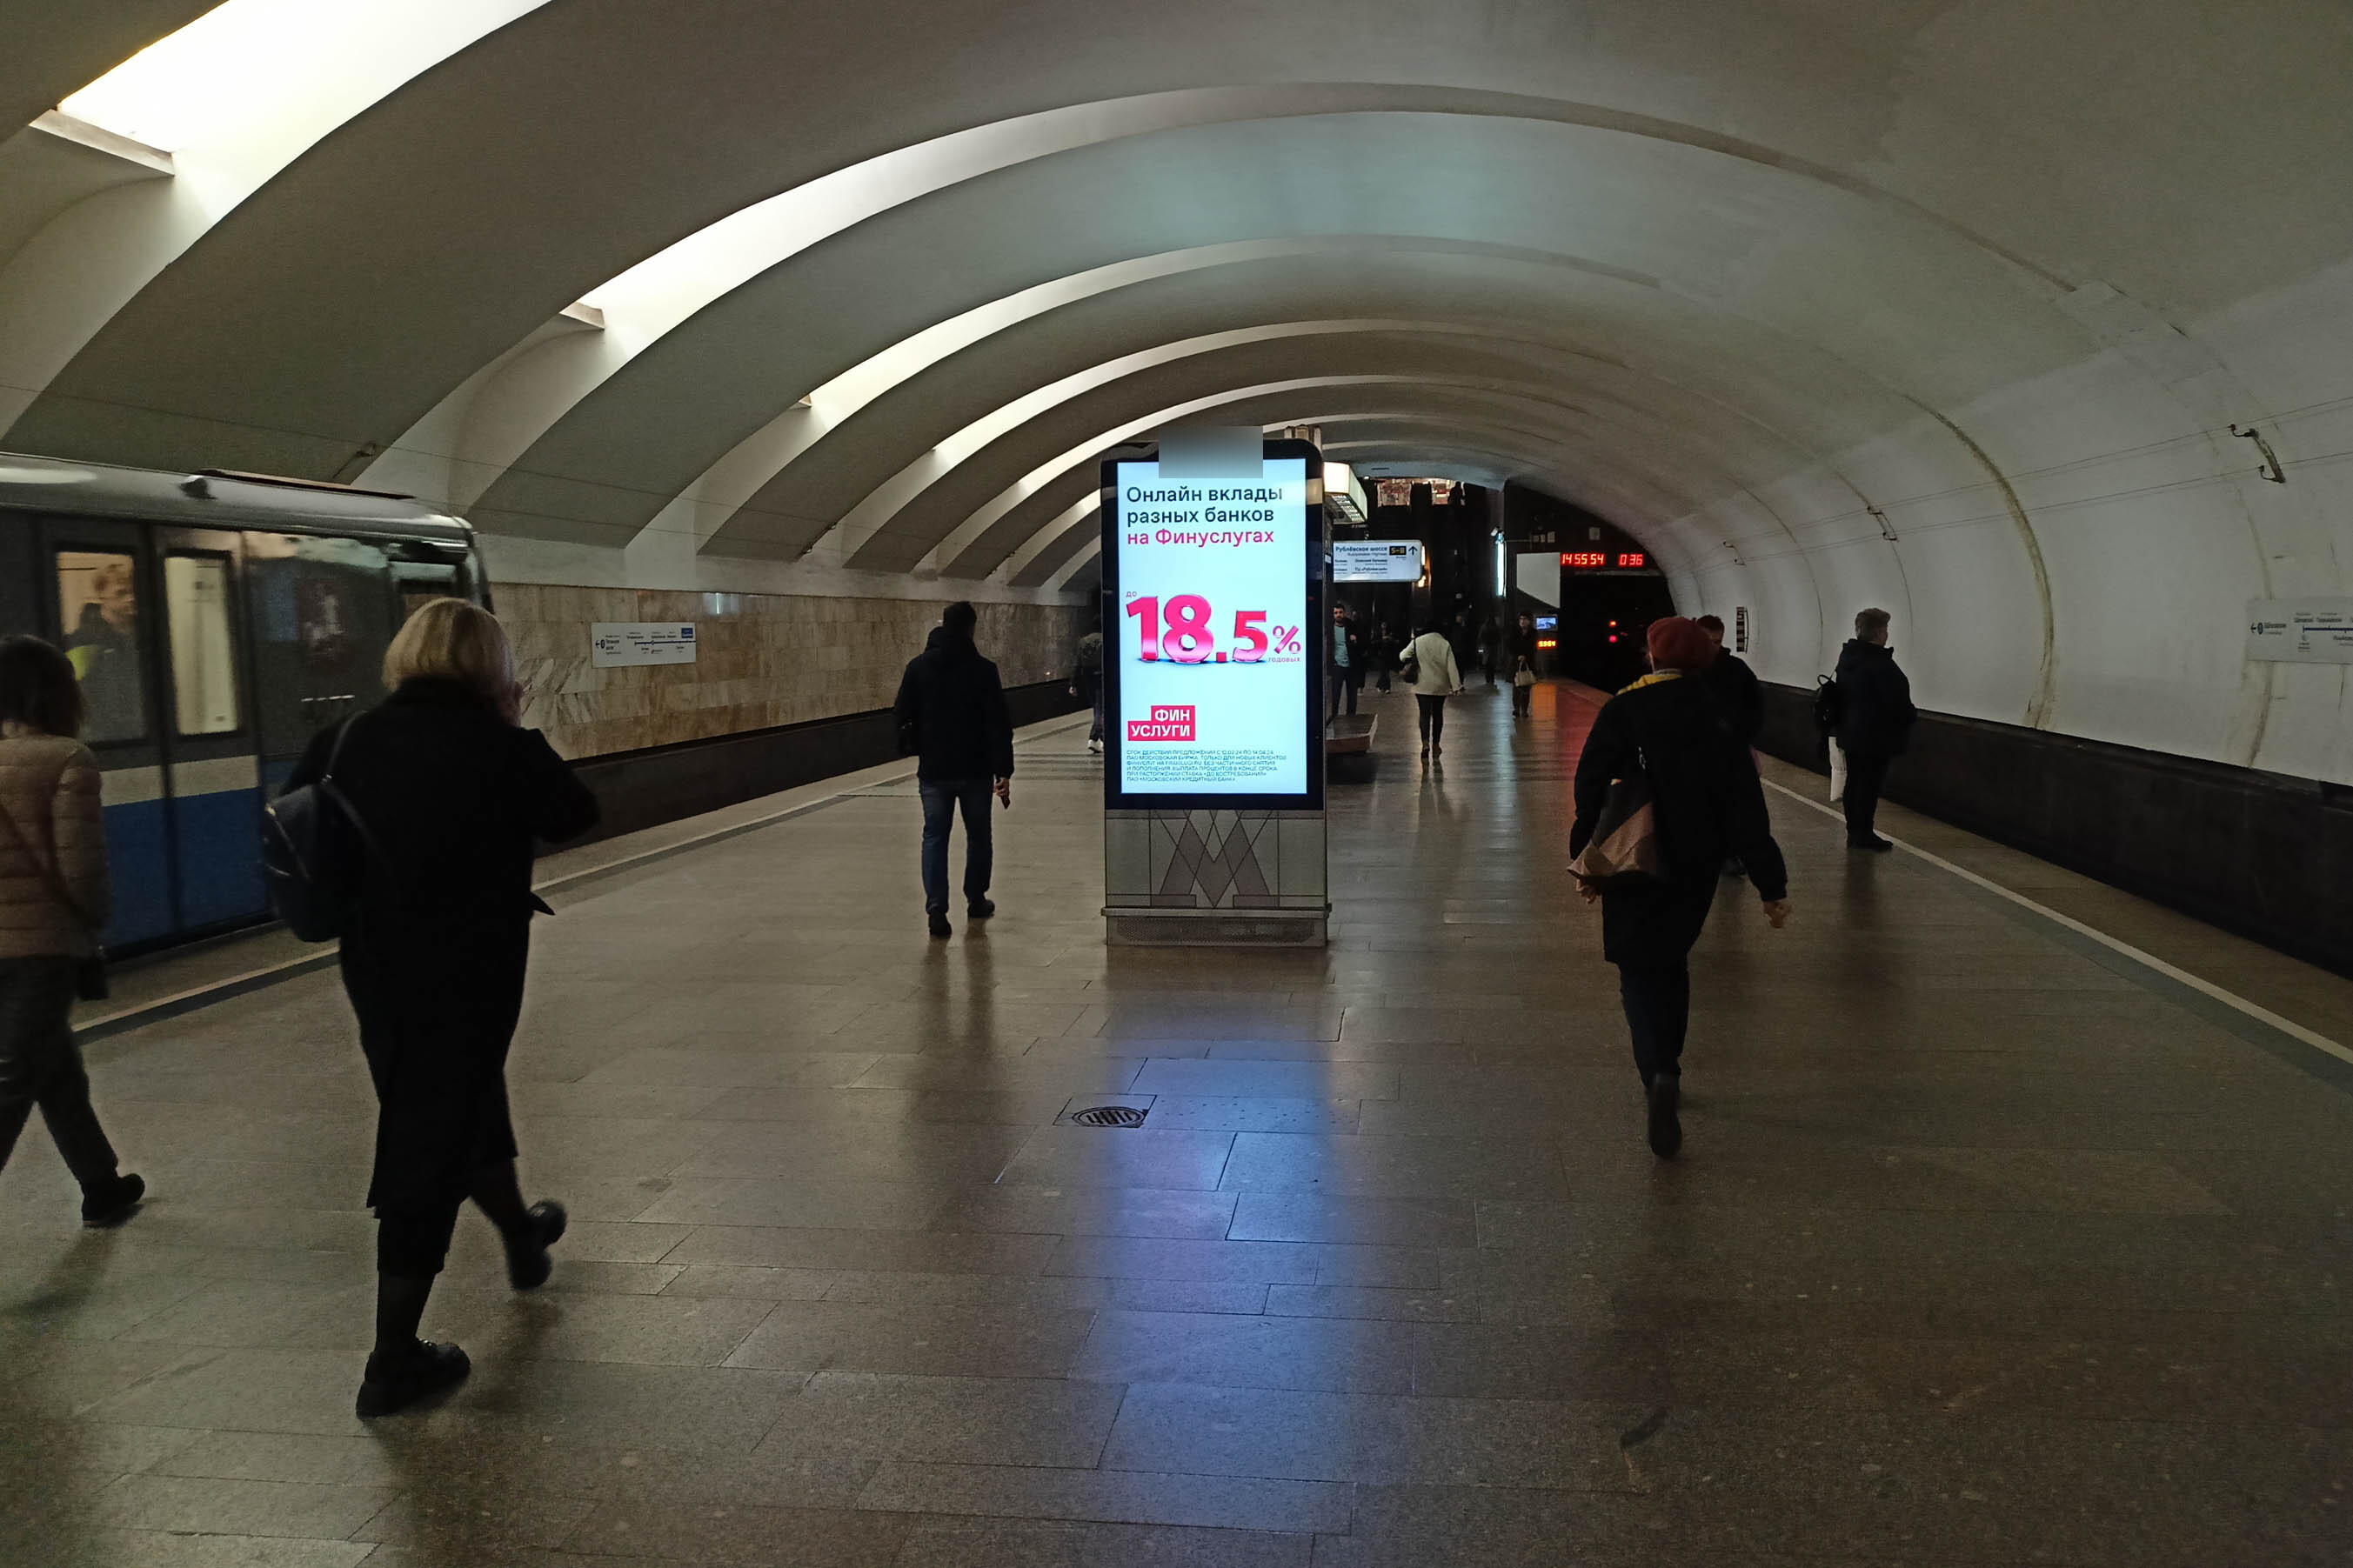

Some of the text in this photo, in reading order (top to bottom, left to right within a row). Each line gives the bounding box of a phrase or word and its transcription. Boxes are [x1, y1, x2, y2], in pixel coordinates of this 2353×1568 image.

[1126, 486, 1282, 503] Онлайн вклады
[1127, 507, 1274, 527] разных банков
[1127, 528, 1274, 548] на Финуслугах
[1154, 709, 1190, 722] ФИН
[1131, 724, 1191, 737] УСЛУГИ
